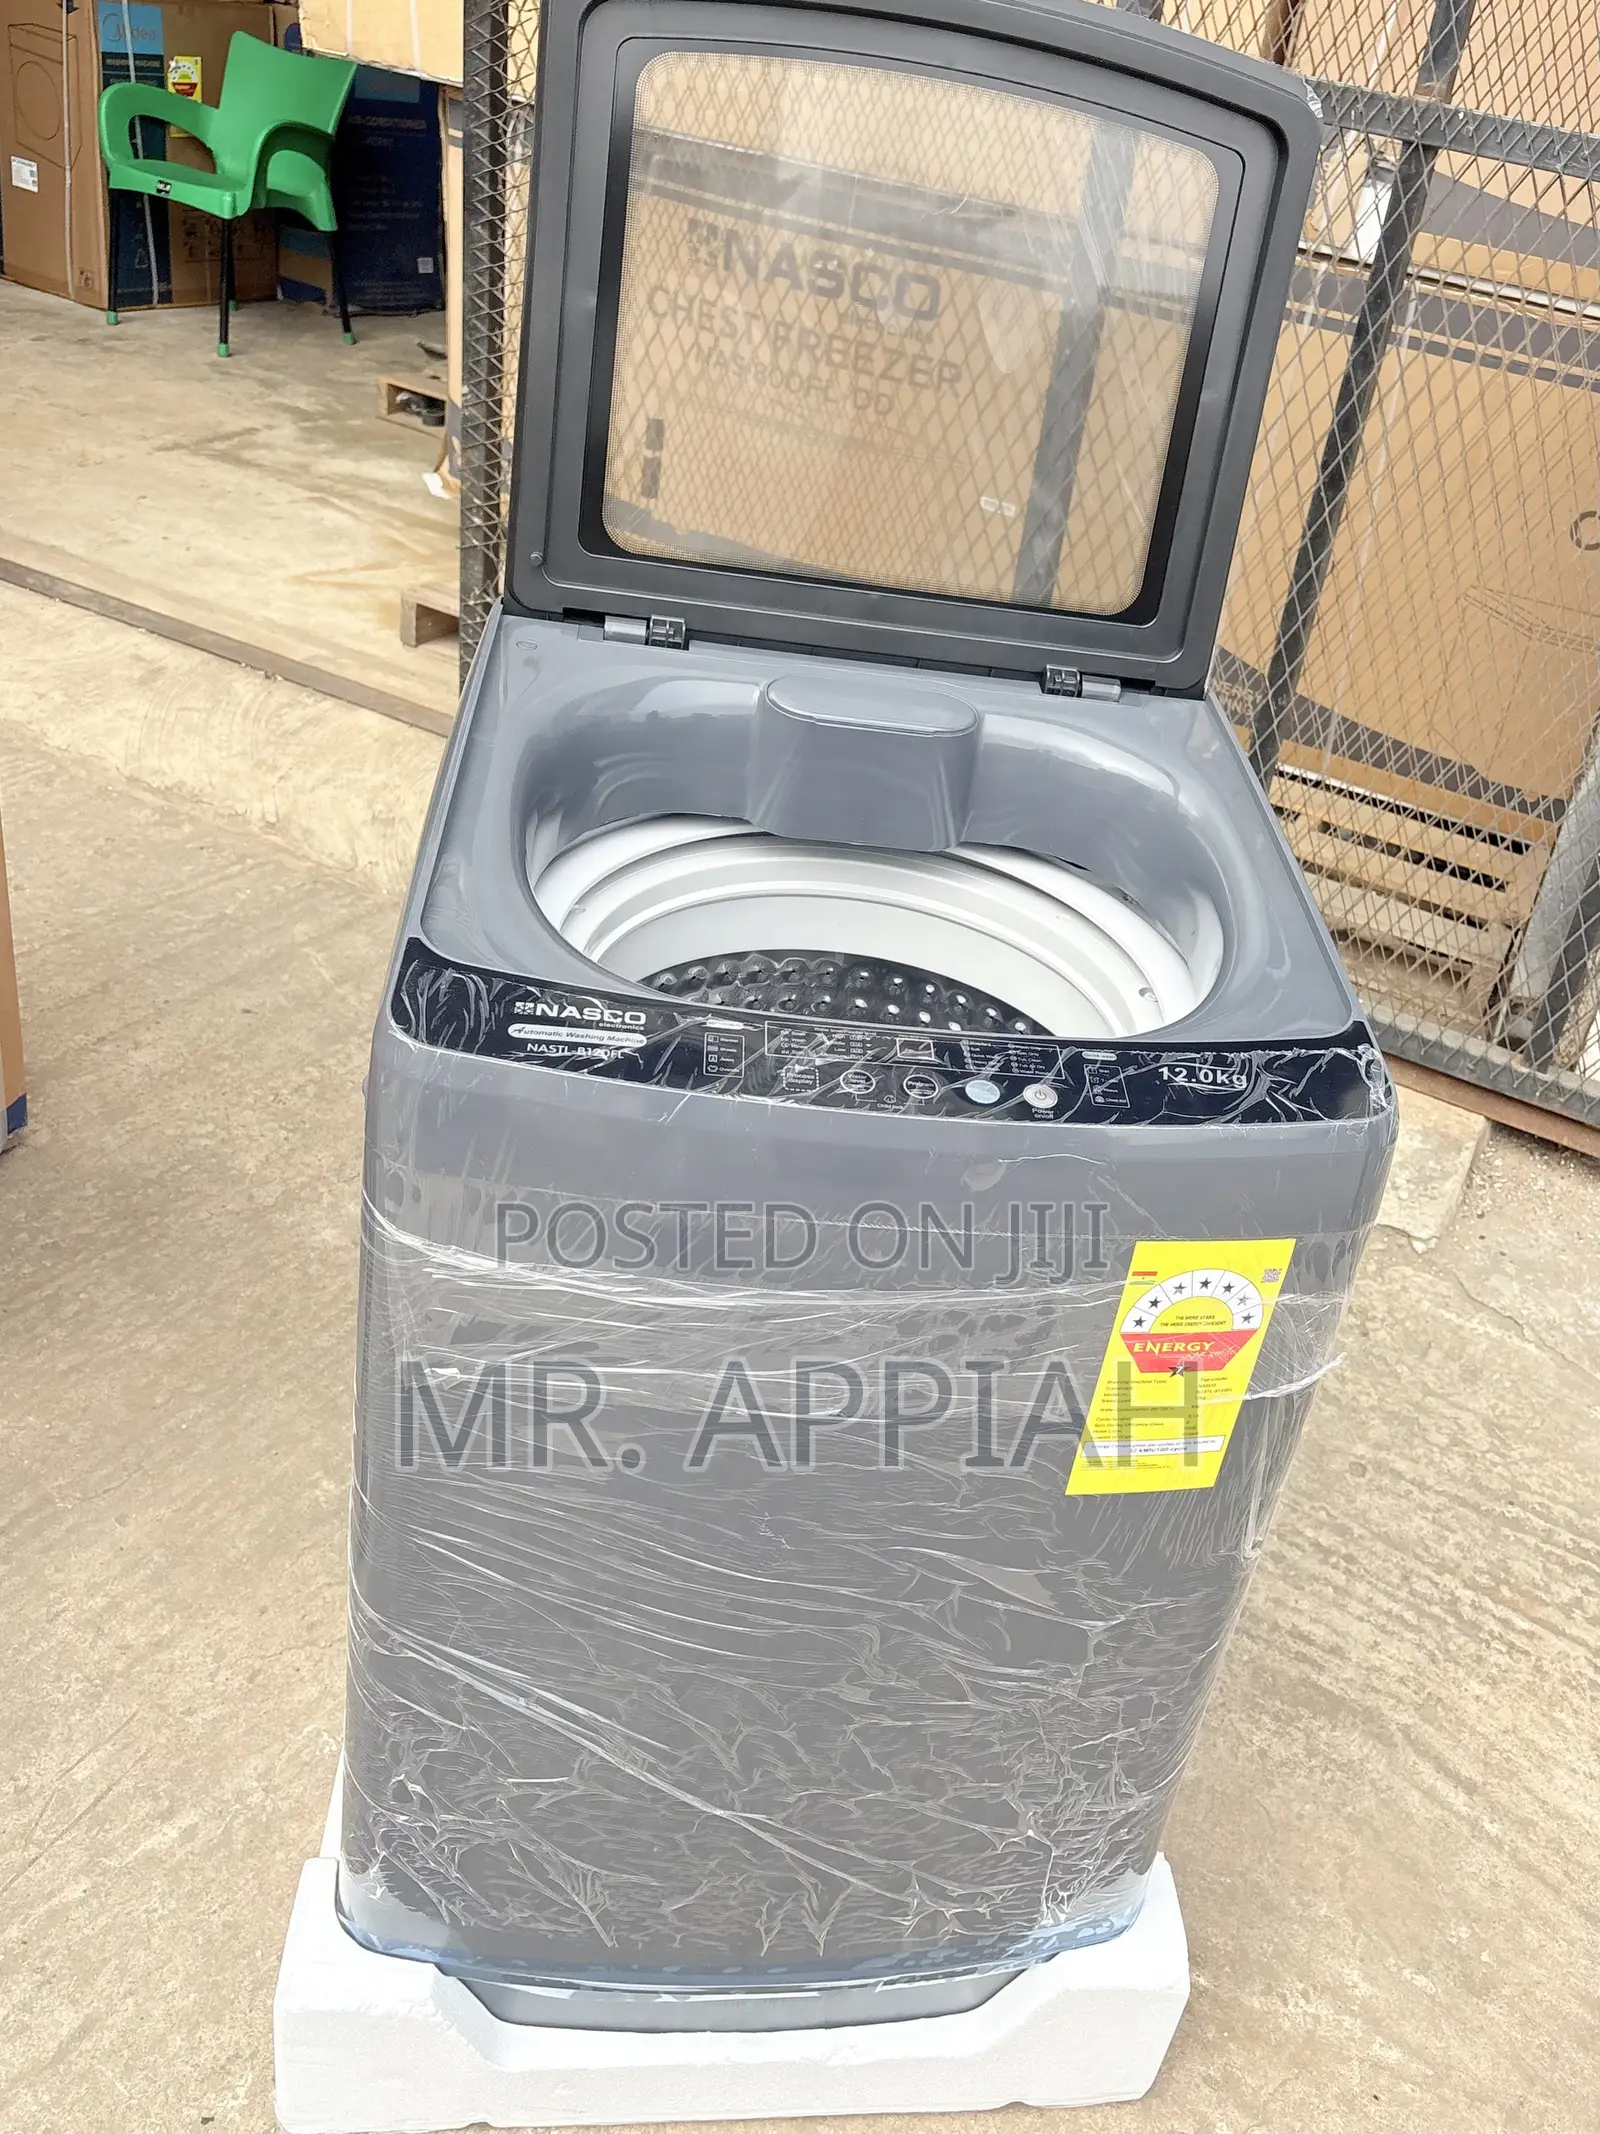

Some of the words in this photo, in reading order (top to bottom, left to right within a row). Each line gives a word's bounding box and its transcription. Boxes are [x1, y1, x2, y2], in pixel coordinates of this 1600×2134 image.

[107, 22, 156, 42] Mdea
[723, 227, 941, 322] NASCO
[650, 284, 761, 340] CHEST
[772, 320, 963, 392] FREEZER
[535, 1003, 646, 1025] NASCO
[511, 1026, 563, 1038] Automatic
[566, 1031, 605, 1042] Washing
[607, 1035, 645, 1044] Machine
[598, 1022, 645, 1031] electronics
[1158, 1066, 1247, 1088] 12.0kg
[1132, 1340, 1215, 1357] ENERGY
